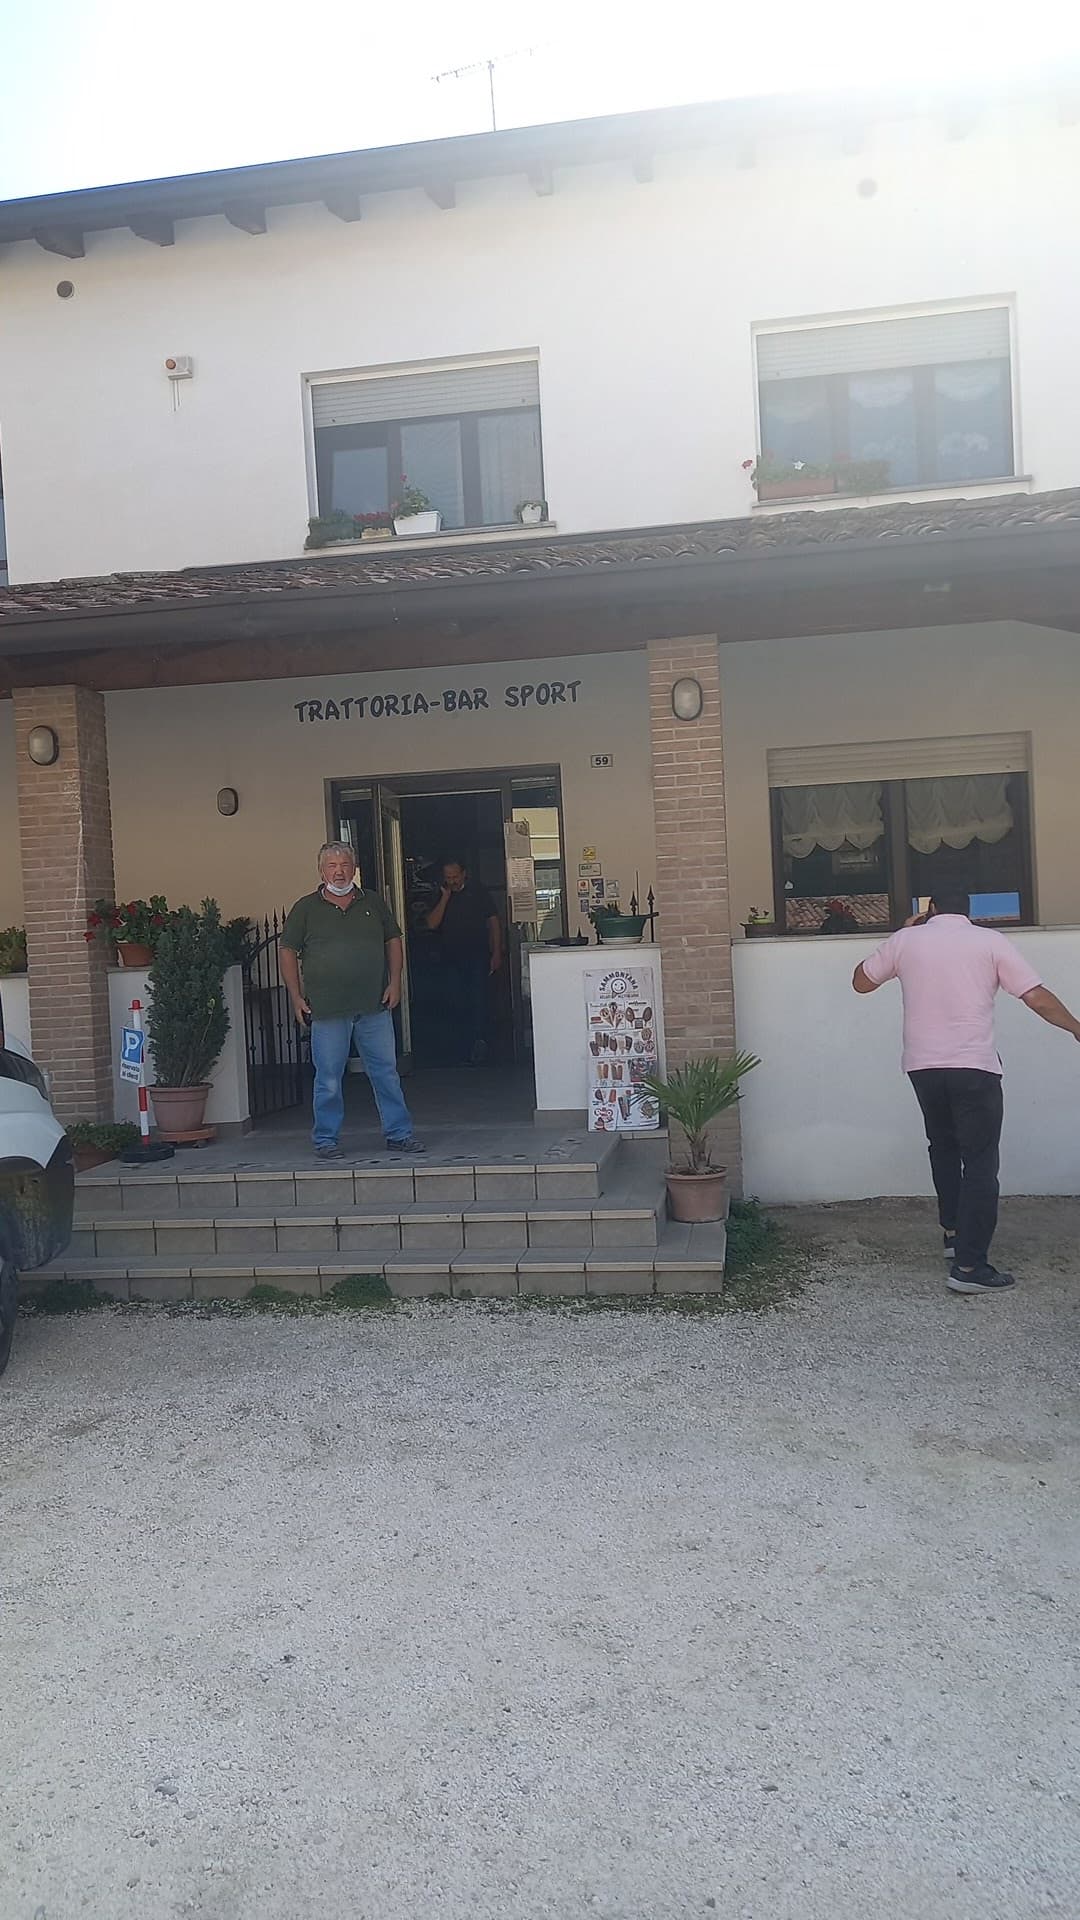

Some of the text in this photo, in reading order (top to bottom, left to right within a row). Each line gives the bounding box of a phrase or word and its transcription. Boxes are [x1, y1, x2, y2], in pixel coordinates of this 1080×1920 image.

[294, 680, 581, 723] TRATTORIA-BAR SPORT
[595, 756, 609, 766] 59
[599, 971, 638, 991] SAMMONTANA
[125, 1031, 140, 1058] P
